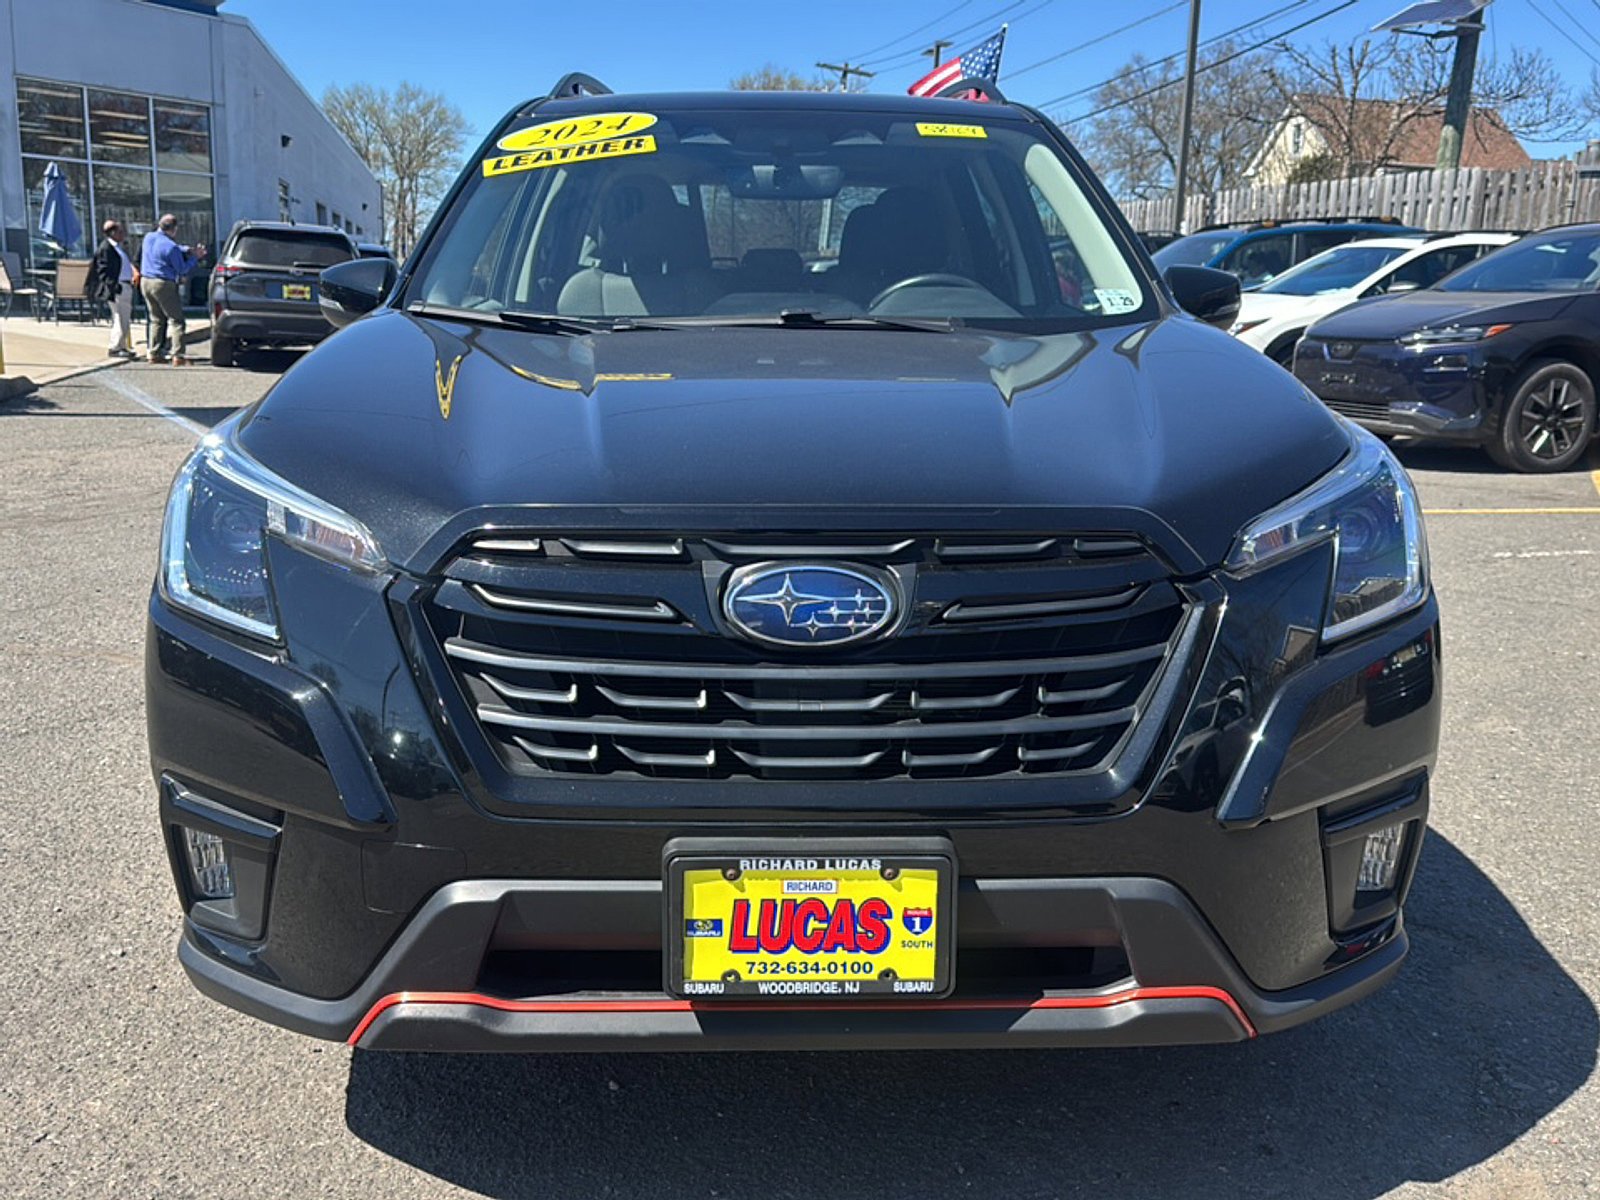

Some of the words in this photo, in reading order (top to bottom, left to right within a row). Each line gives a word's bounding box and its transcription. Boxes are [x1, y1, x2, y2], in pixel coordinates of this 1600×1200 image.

[528, 115, 633, 146] 2024
[492, 138, 645, 170] LEATHER
[740, 859, 818, 871] RICHARD
[825, 859, 882, 871] LUCAS
[786, 881, 833, 892] RICHARD
[728, 897, 893, 954] LUCAS
[911, 916, 923, 933] 1
[901, 940, 933, 948] SOUTH
[746, 961, 874, 975] 732-634-0100
[683, 982, 725, 994] SUBARU
[844, 981, 860, 993] NJ
[893, 981, 934, 992] SUBARU
